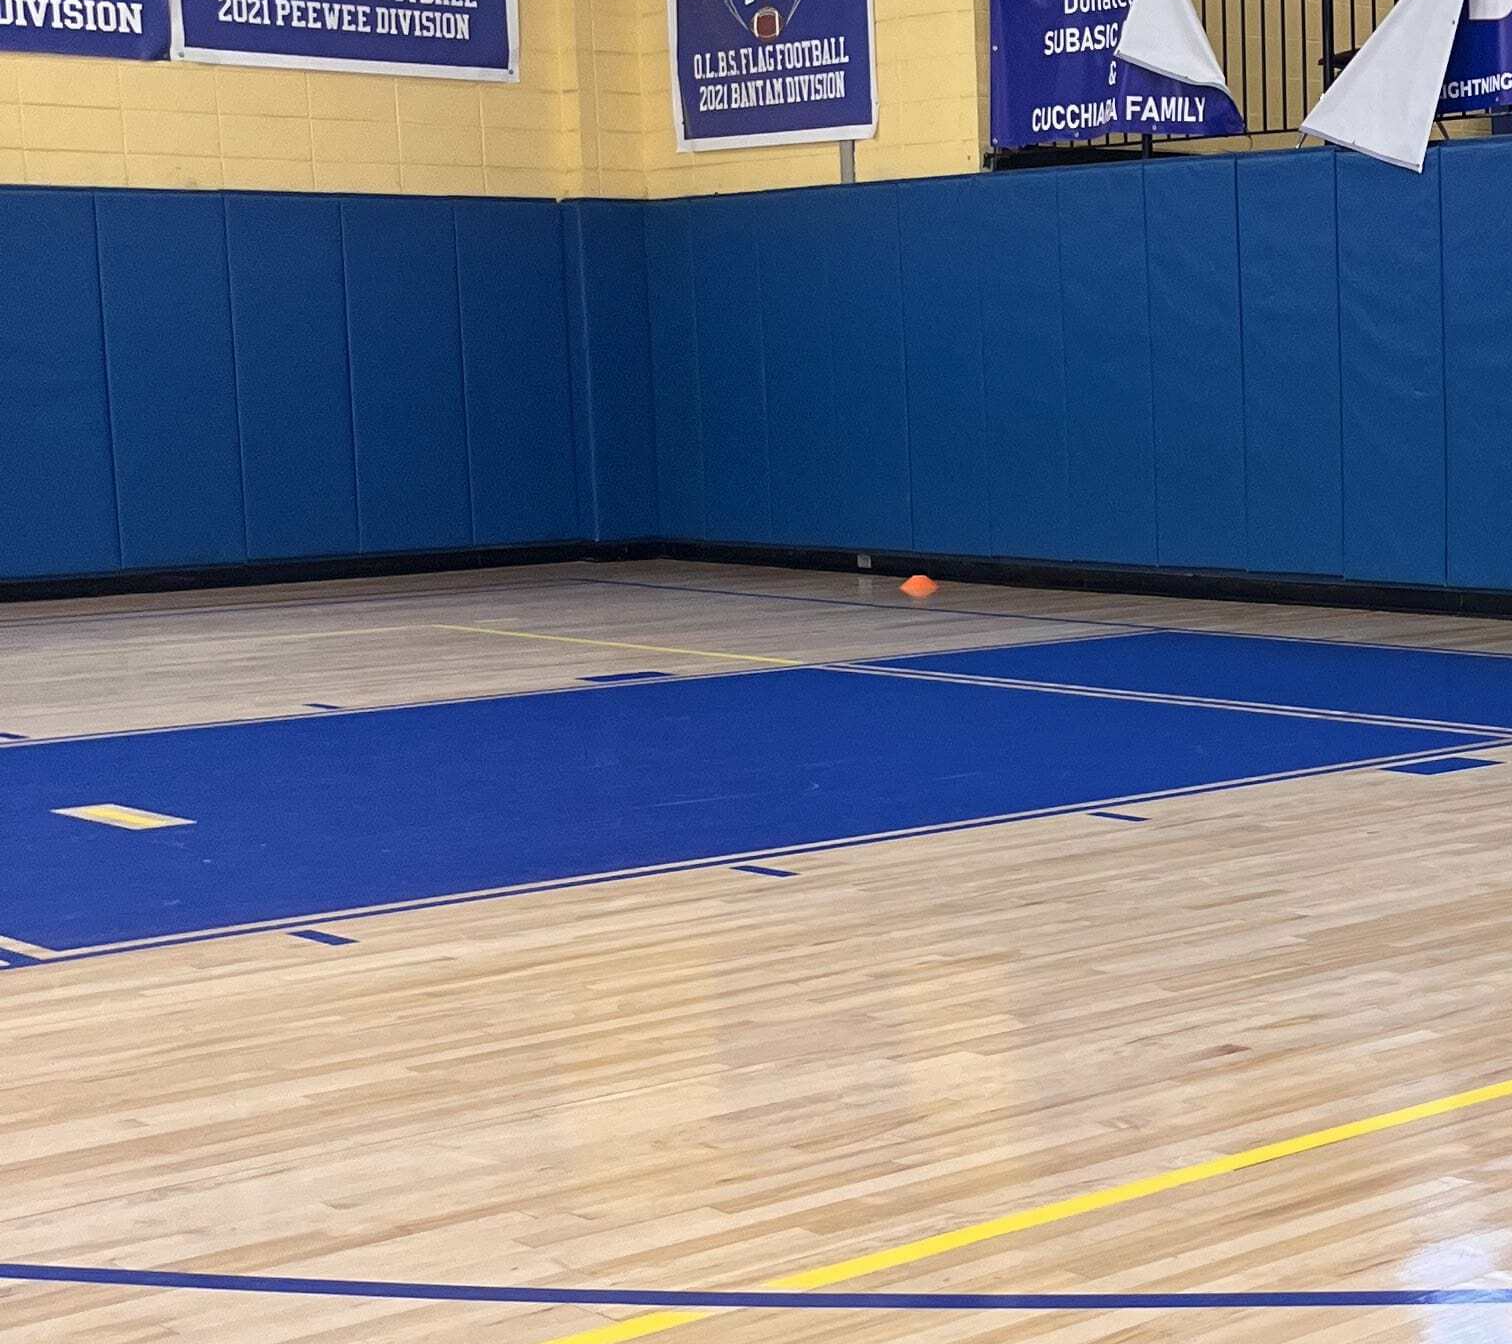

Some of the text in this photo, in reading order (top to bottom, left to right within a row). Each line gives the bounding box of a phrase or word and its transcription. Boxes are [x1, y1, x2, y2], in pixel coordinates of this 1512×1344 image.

[376, 7, 470, 40] DIVISION
[1044, 22, 1119, 56] SUBASIC
[694, 36, 849, 79] O.L.B.S. FLAG FOOTBALL
[1108, 61, 1117, 85] &
[699, 70, 845, 112] 2021 BANTAM DIVISION
[1440, 72, 1512, 99] IGHTNING
[1126, 95, 1206, 123] FAMILY
